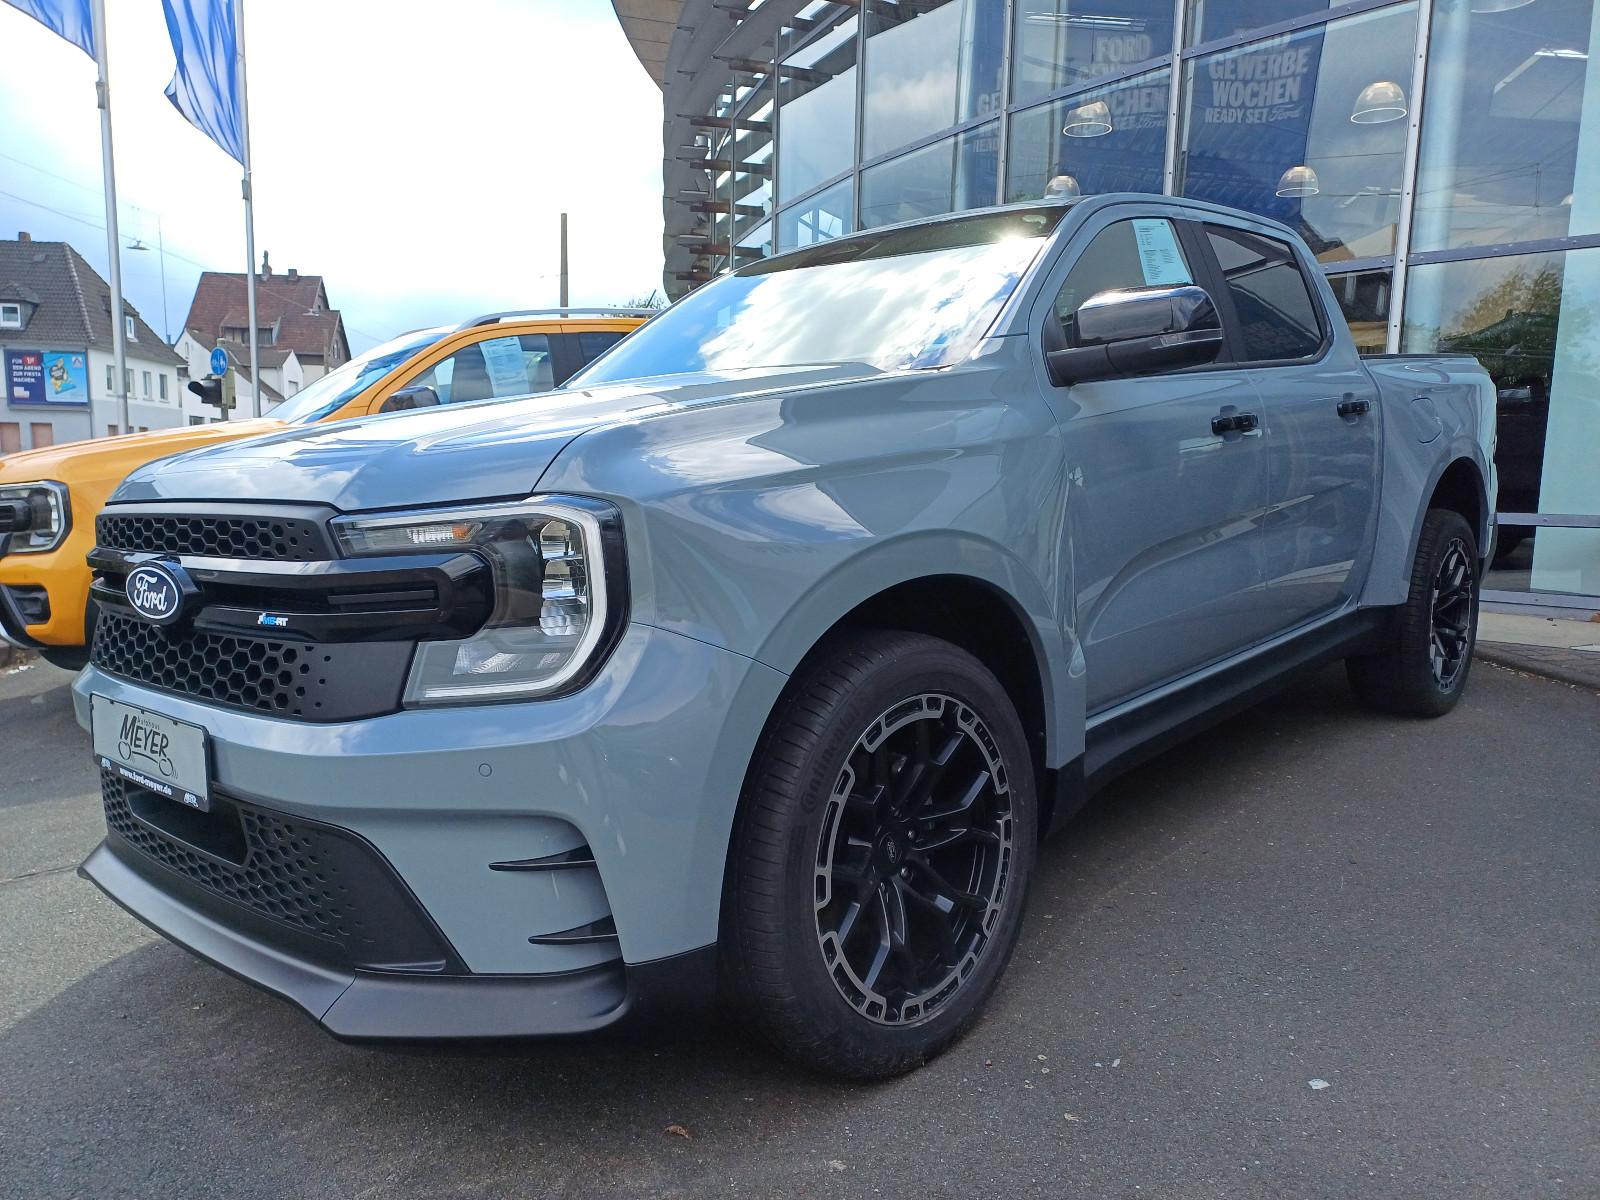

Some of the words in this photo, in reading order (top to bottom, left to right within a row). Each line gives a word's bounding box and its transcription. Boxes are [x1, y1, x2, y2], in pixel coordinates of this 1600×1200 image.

[1095, 33, 1152, 62] FORD
[1208, 46, 1312, 80] GEWERBE
[1212, 77, 1301, 108] WOCHEN
[1205, 108, 1245, 123] READY
[1245, 107, 1269, 123] SET
[134, 573, 168, 611] Ford
[120, 714, 169, 758] MEYER
